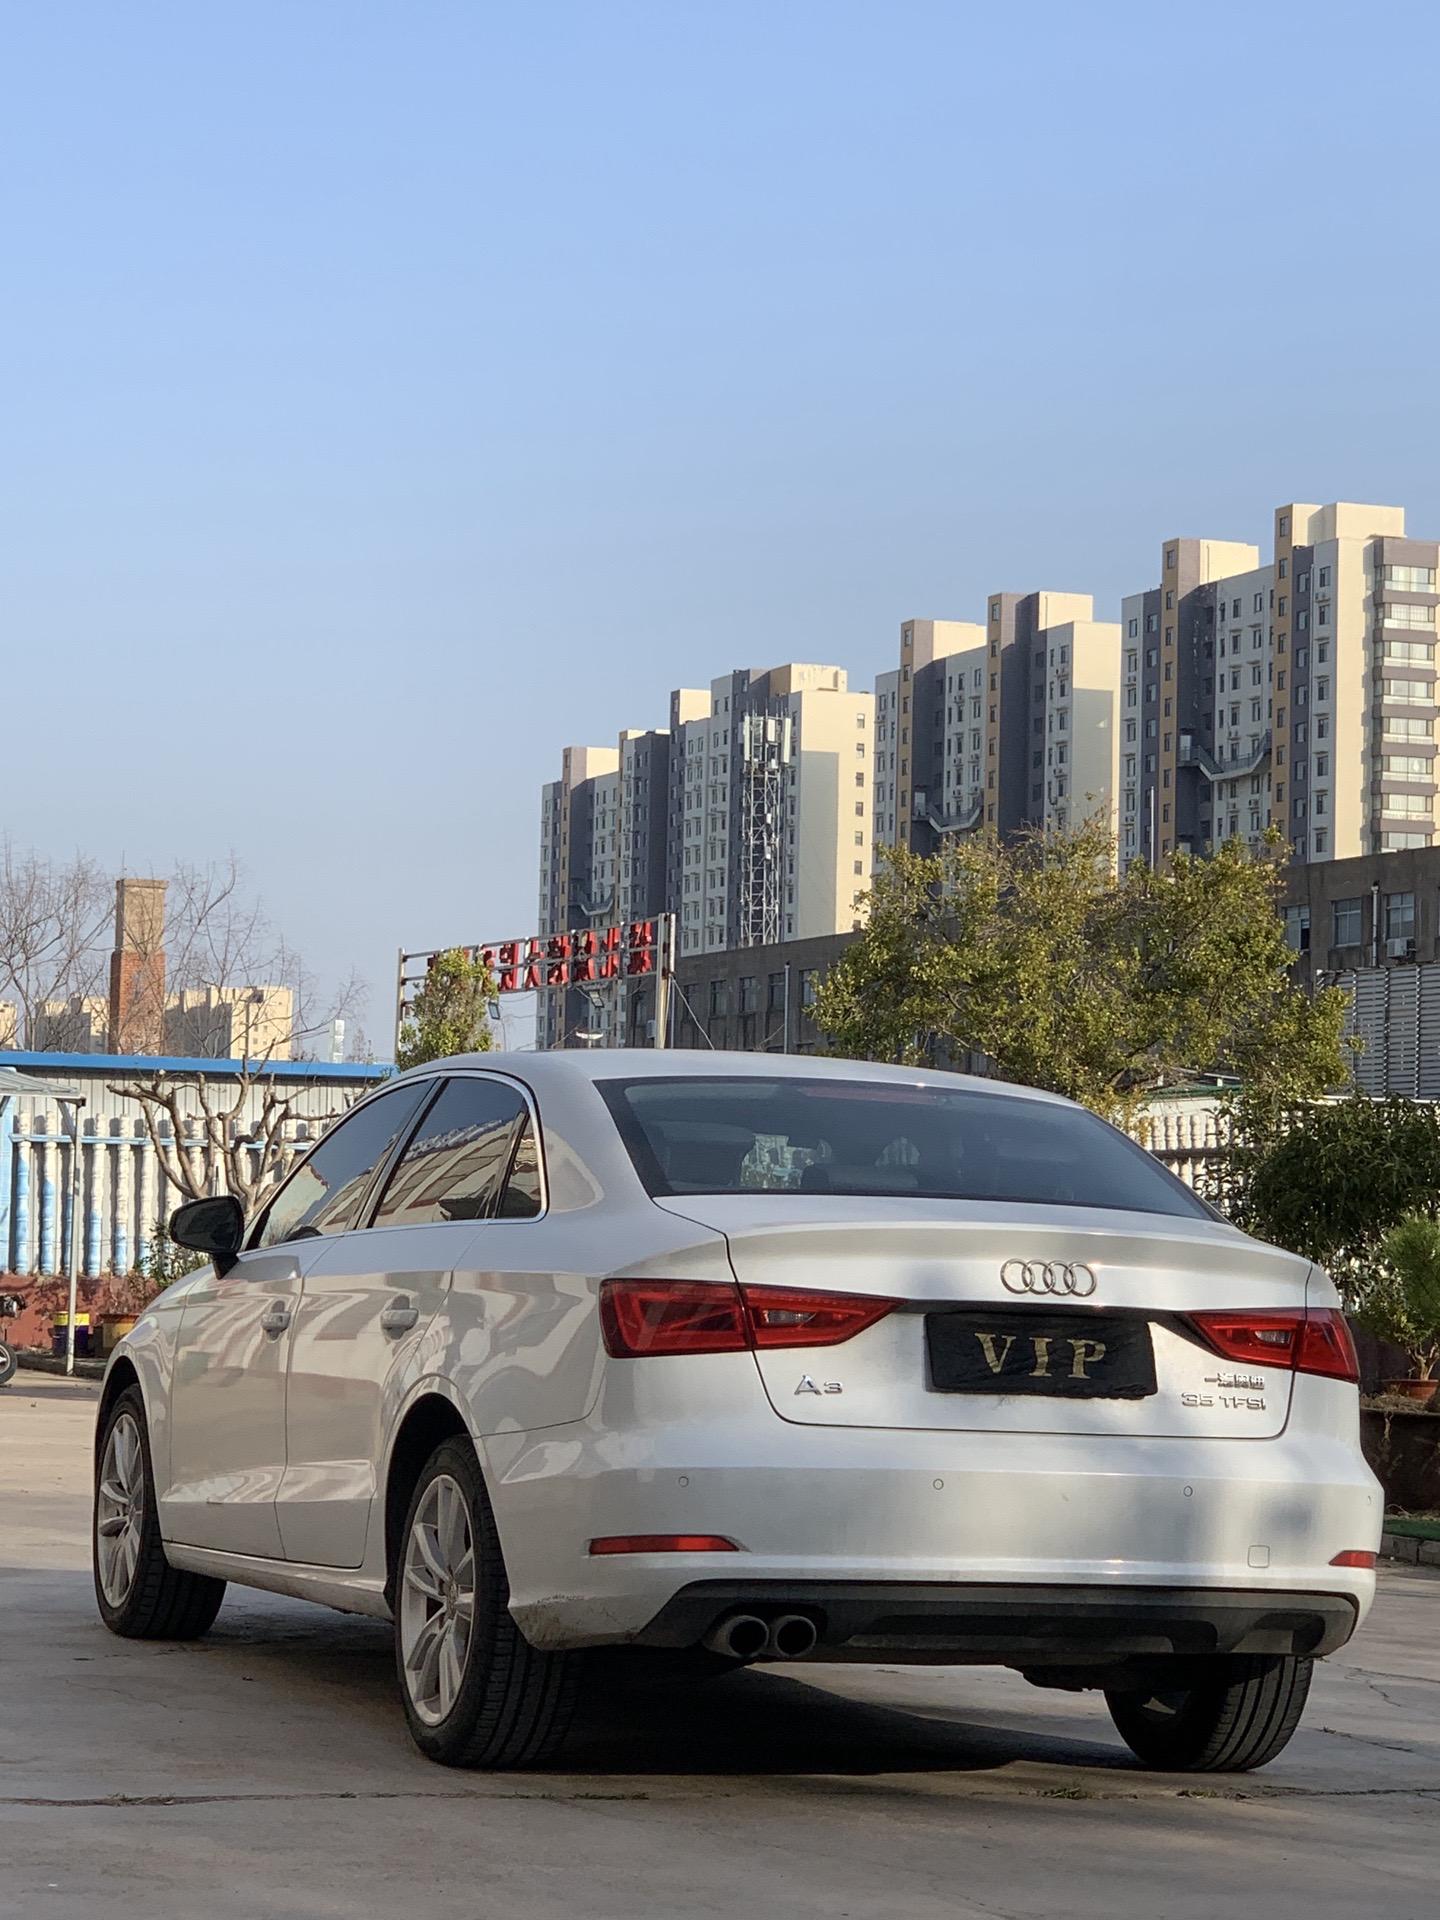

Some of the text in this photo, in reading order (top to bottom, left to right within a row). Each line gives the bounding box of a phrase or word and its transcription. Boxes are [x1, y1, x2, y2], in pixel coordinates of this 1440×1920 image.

[973, 1332, 1107, 1380] VIP
[793, 1374, 843, 1396] A3
[1181, 1391, 1266, 1411] 35 TFSI
